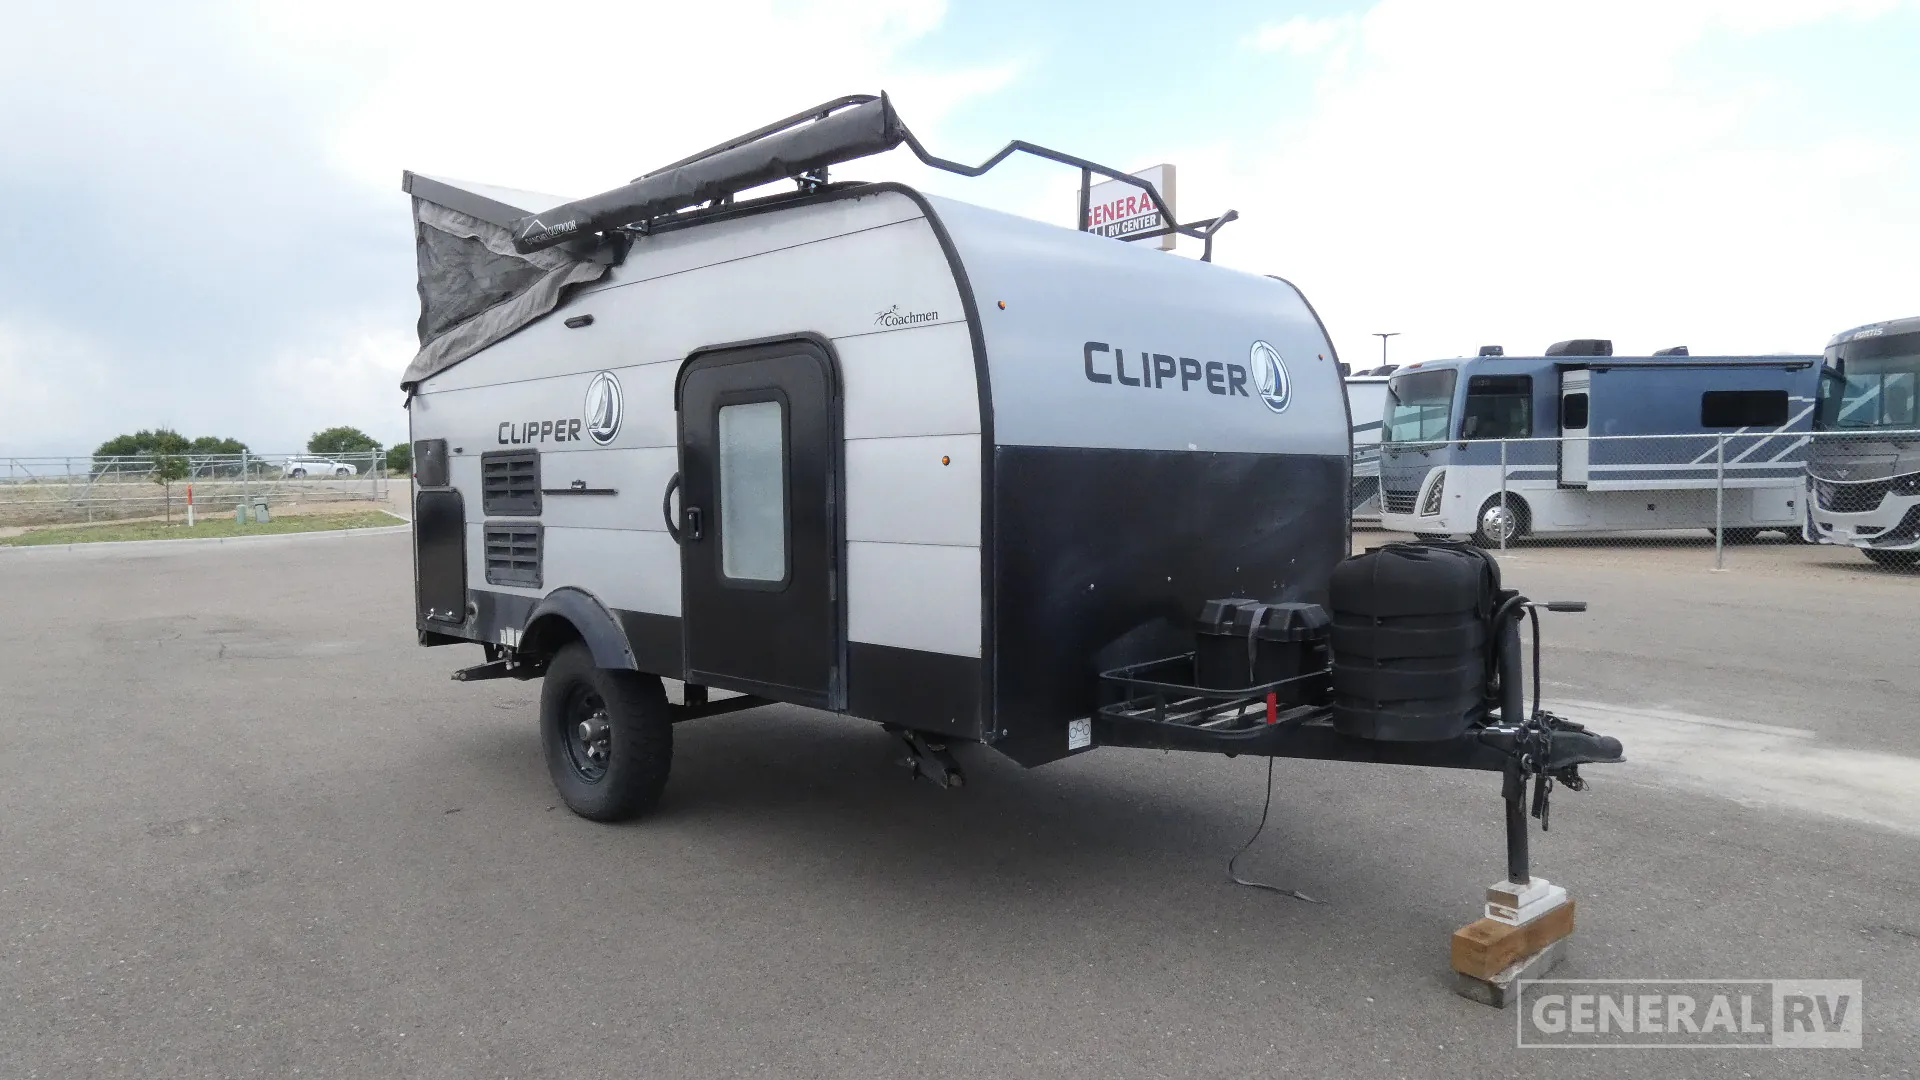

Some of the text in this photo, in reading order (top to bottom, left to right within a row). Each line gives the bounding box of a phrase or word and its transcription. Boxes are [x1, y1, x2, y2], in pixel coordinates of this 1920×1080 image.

[1088, 190, 1157, 227] ENERA
[1108, 214, 1157, 237] RV CENTER
[884, 311, 939, 327] Coachmen
[1083, 341, 1250, 398] CLIPPER
[498, 418, 581, 445] CLIPPER
